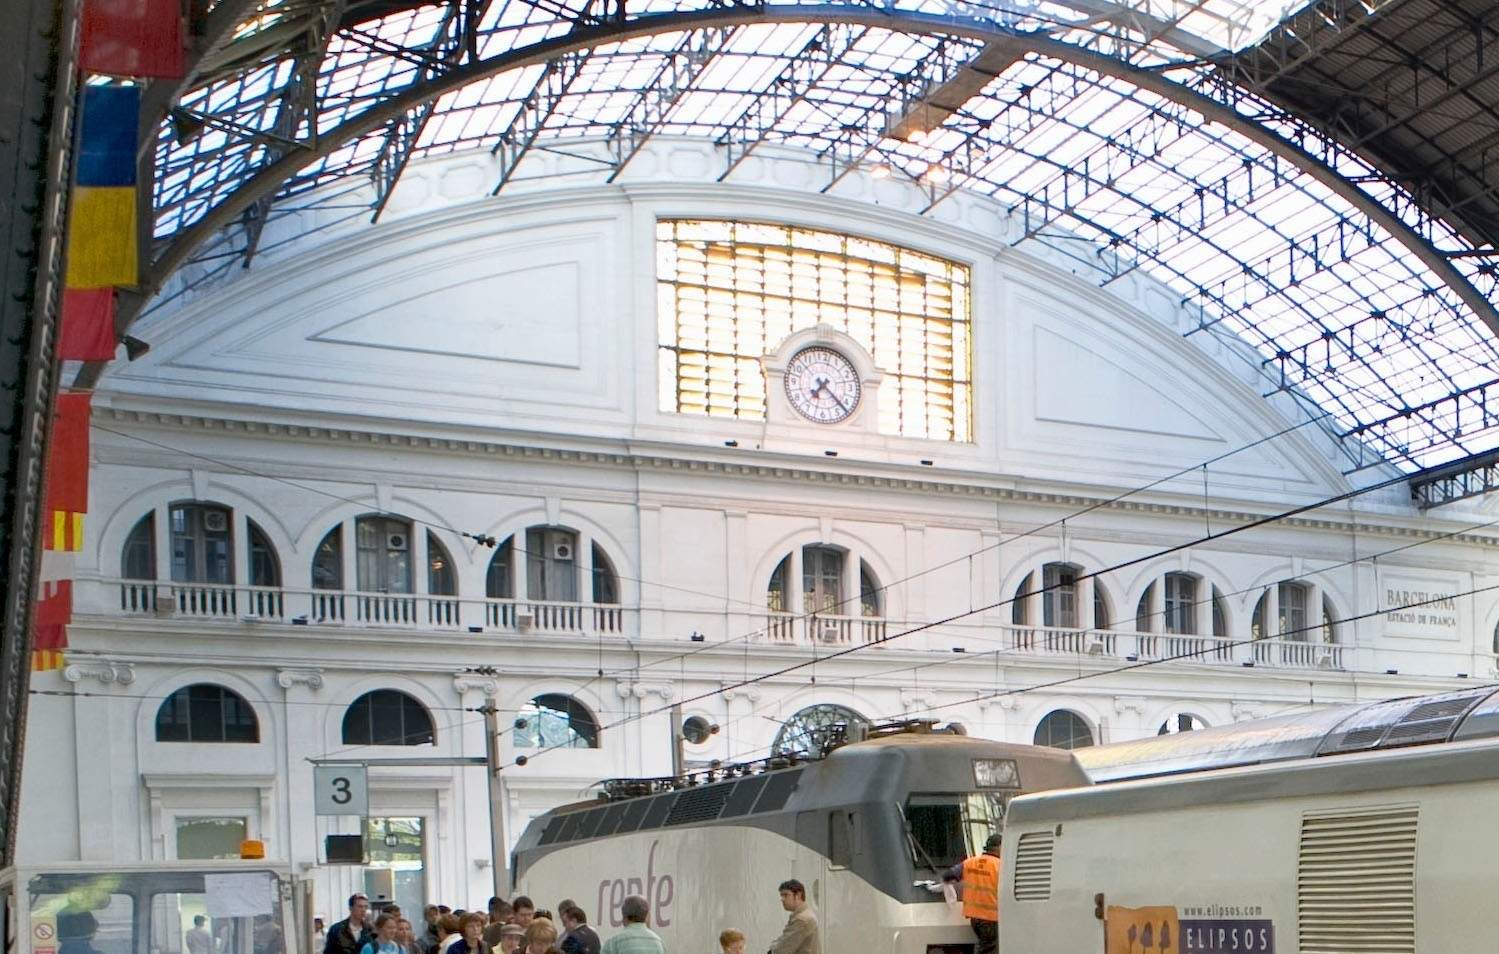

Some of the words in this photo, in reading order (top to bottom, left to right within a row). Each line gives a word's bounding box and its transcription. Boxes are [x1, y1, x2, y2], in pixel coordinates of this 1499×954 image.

[1387, 589, 1457, 611] BARCELONA
[331, 777, 352, 805] 3
[1183, 905, 1263, 918] www.elipsos.com
[1186, 928, 1268, 951] ELIPSOS
